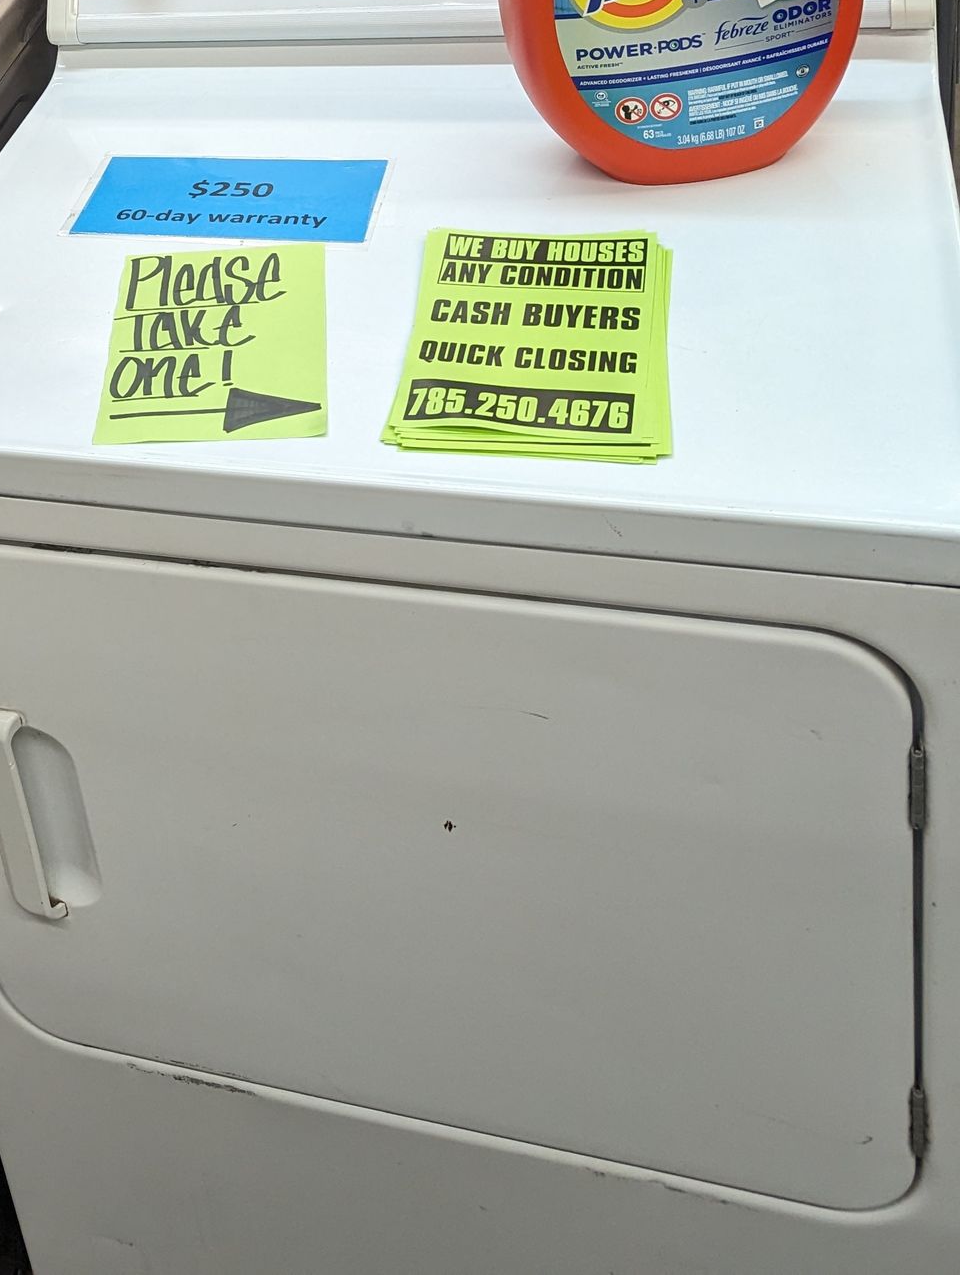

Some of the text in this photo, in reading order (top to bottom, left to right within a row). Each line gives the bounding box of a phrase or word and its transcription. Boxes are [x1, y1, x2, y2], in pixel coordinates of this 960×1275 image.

[714, 11, 832, 46] febreze ELIMINATORS
[765, 31, 792, 42] SPORT
[608, 76, 642, 85] DEODORIZER
[646, 72, 668, 81] LASTING
[669, 68, 699, 78] FRESHENER
[643, 130, 655, 139] 63
[676, 135, 691, 145] 3.04
[691, 134, 699, 144] kg
[699, 131, 714, 144] (6.68
[715, 129, 725, 141] LB)
[737, 124, 746, 135] OZ
[189, 180, 274, 199] $250
[116, 209, 327, 228] 60-day warranty
[448, 235, 645, 263] WE BUY HOUSES
[440, 261, 643, 290] ANY CONDITION
[430, 299, 641, 331] CASH BUYERS
[418, 340, 638, 373] QUICK CLOSING
[408, 387, 630, 429] 785.250.4676
